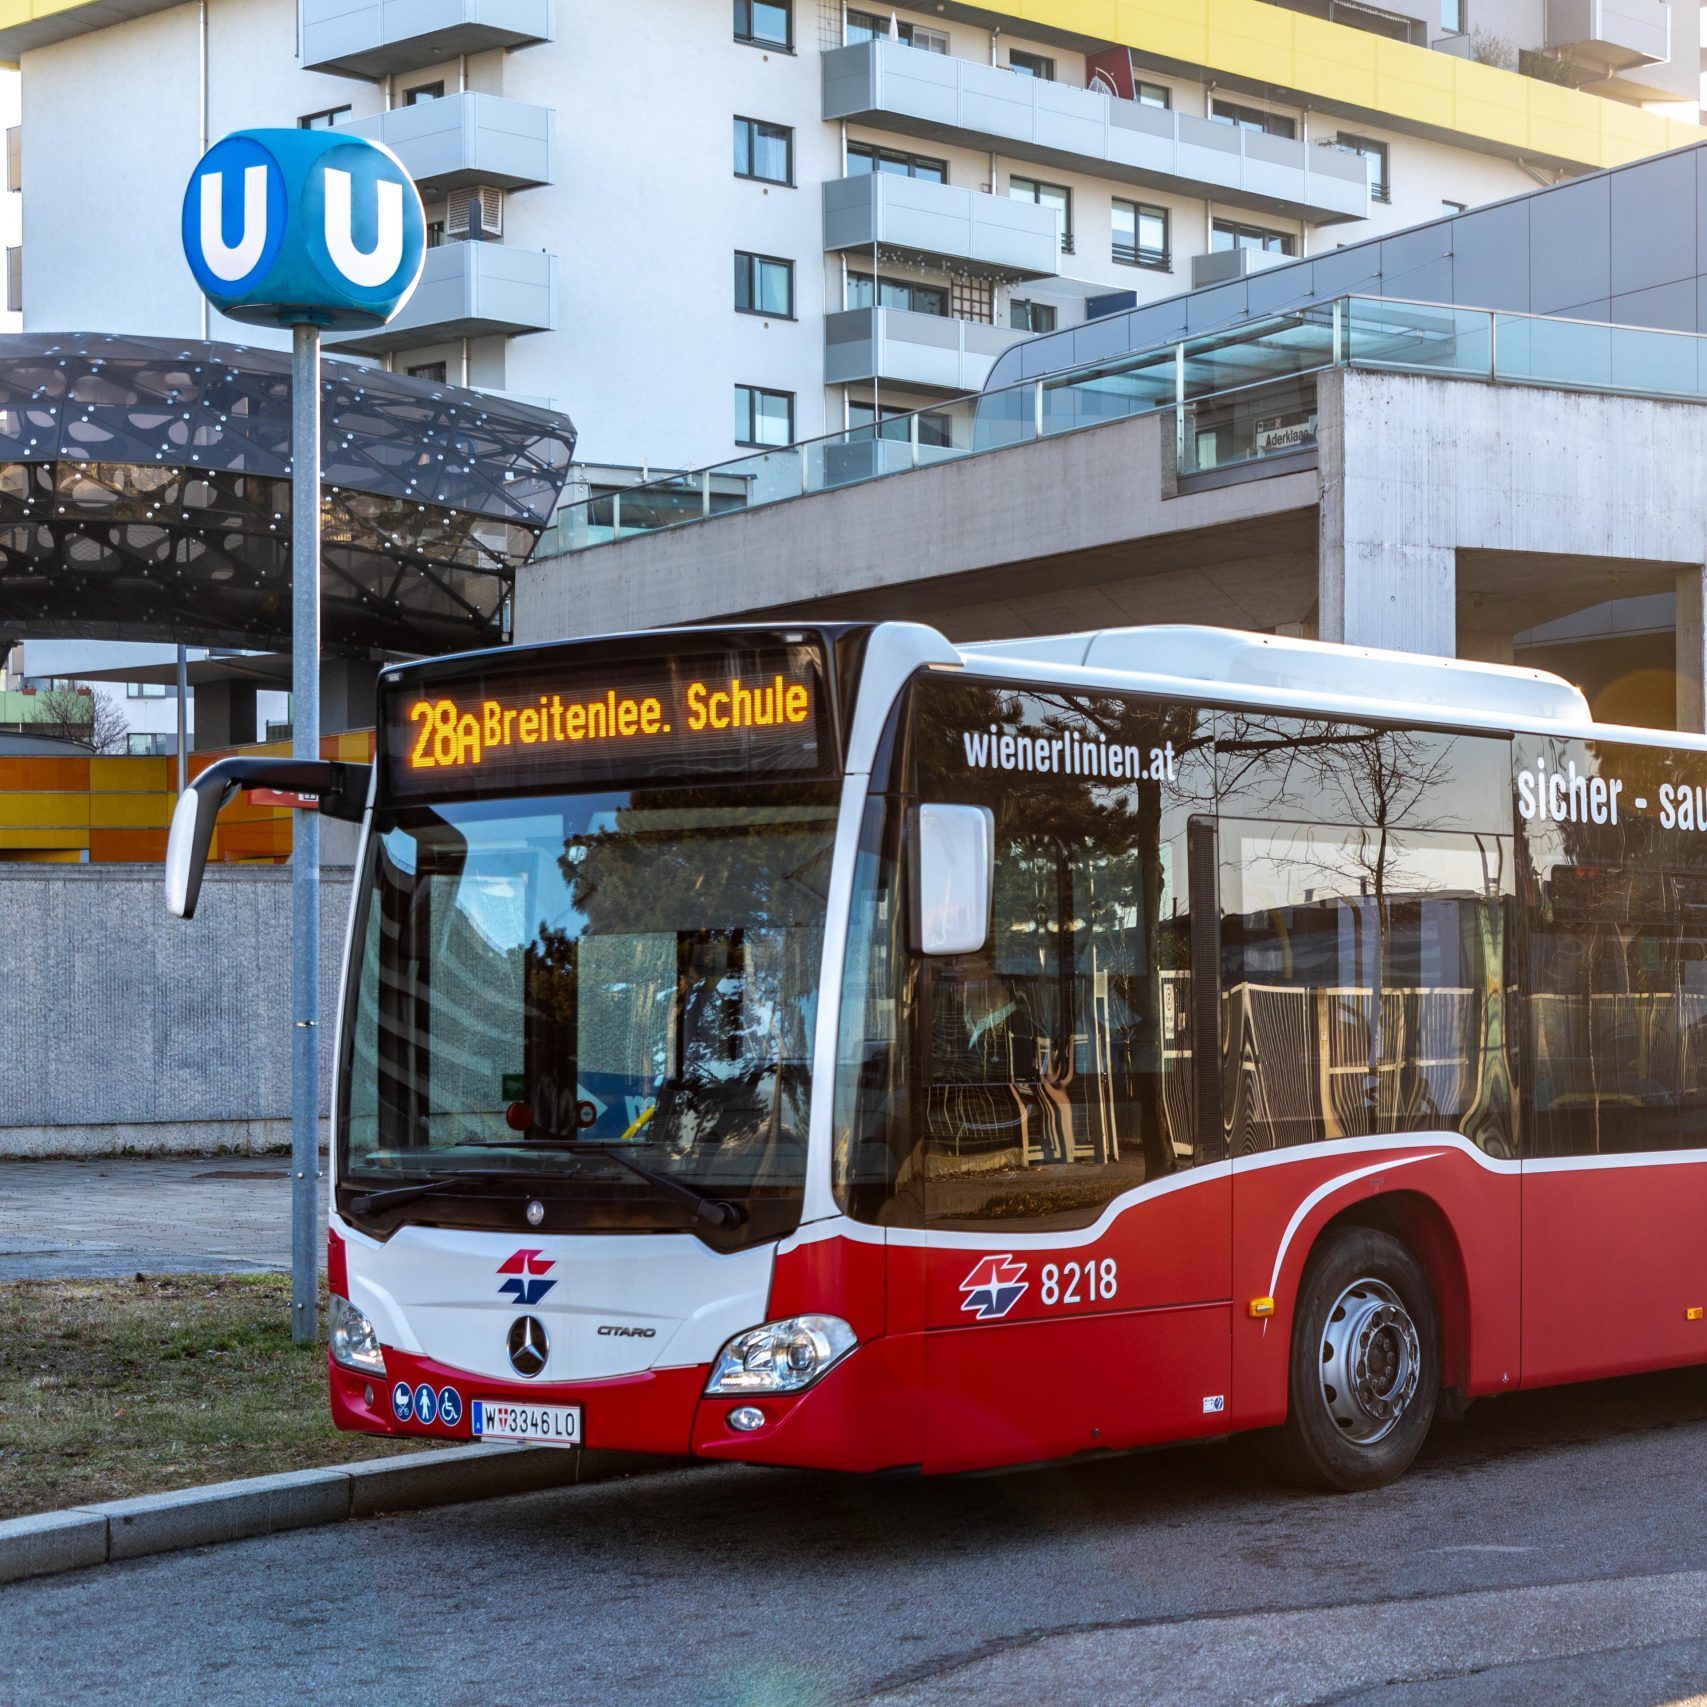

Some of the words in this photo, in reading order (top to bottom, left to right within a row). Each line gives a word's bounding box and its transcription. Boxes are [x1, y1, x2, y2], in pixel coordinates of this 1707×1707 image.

[200, 164, 267, 282] U
[324, 167, 403, 288] U
[410, 699, 481, 768] 28A
[482, 689, 671, 747] Breitenlee.
[686, 674, 809, 731] Schule
[963, 723, 1176, 782] wienerlinien.at
[1517, 756, 1623, 826] sicher
[1041, 1257, 1117, 1306] 8218
[597, 1325, 657, 1338] CITARO
[485, 1407, 496, 1431] W
